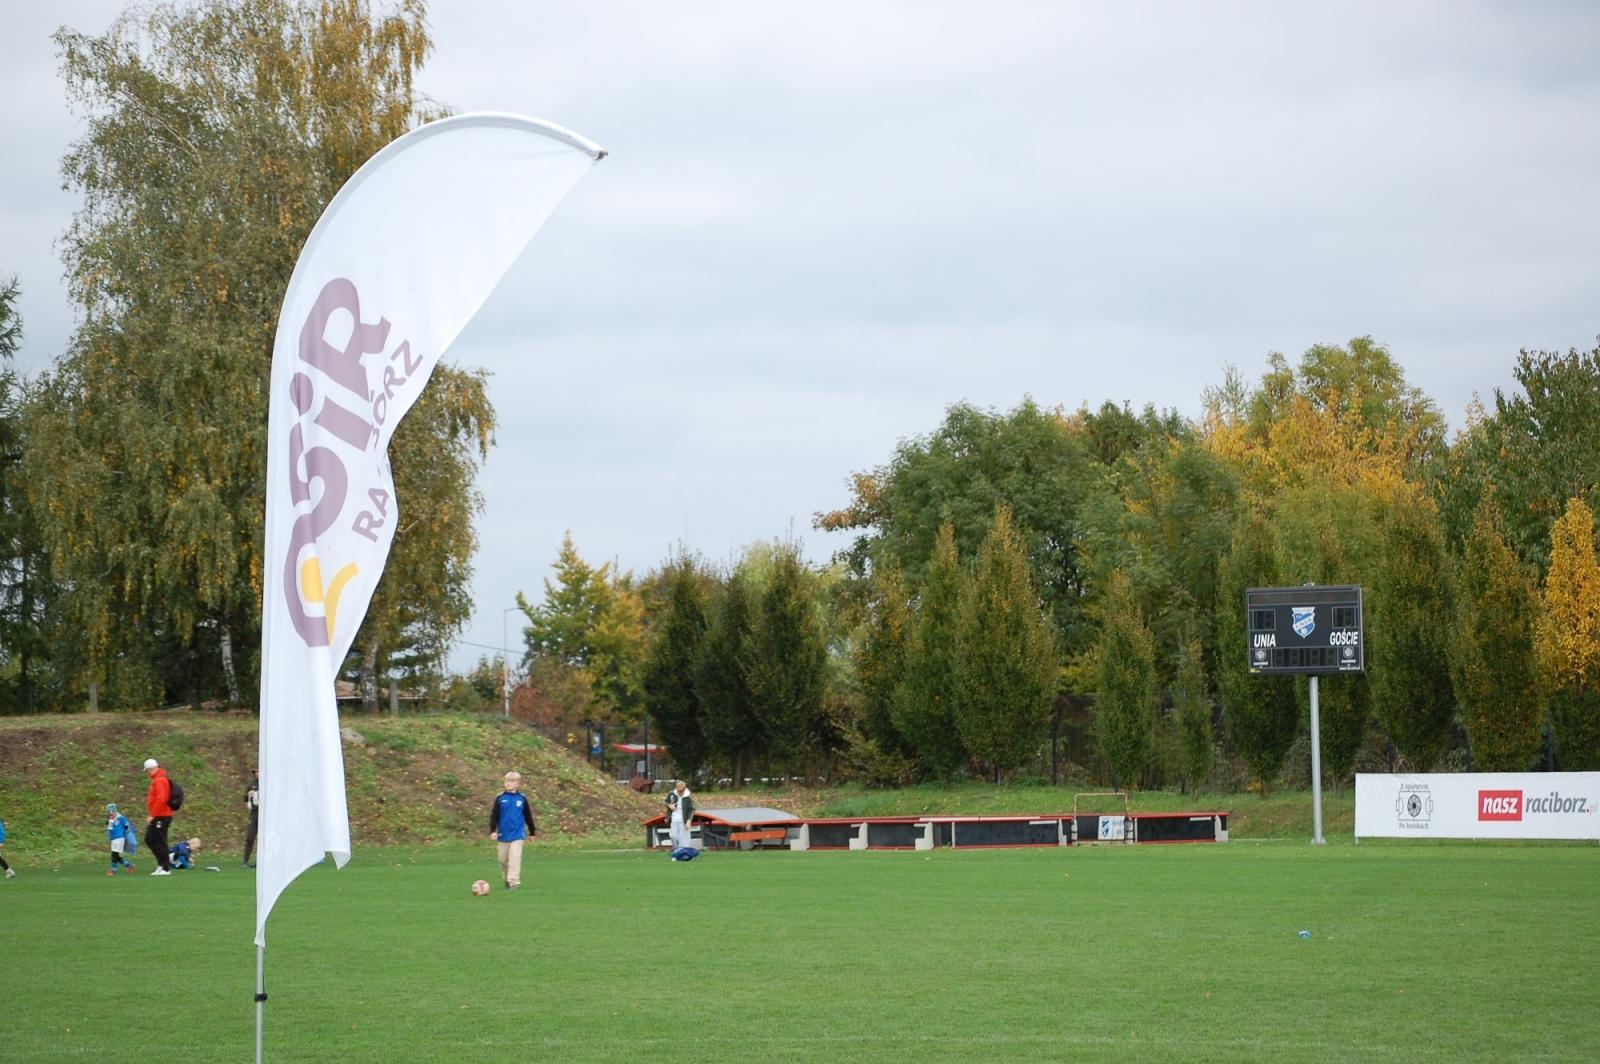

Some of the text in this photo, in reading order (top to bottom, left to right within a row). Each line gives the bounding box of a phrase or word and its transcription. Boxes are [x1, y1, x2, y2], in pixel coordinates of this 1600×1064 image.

[1253, 633, 1277, 648] UNIA
[1329, 628, 1359, 646] GOŚCIE
[1482, 792, 1598, 816] nasz raciborz.pl
